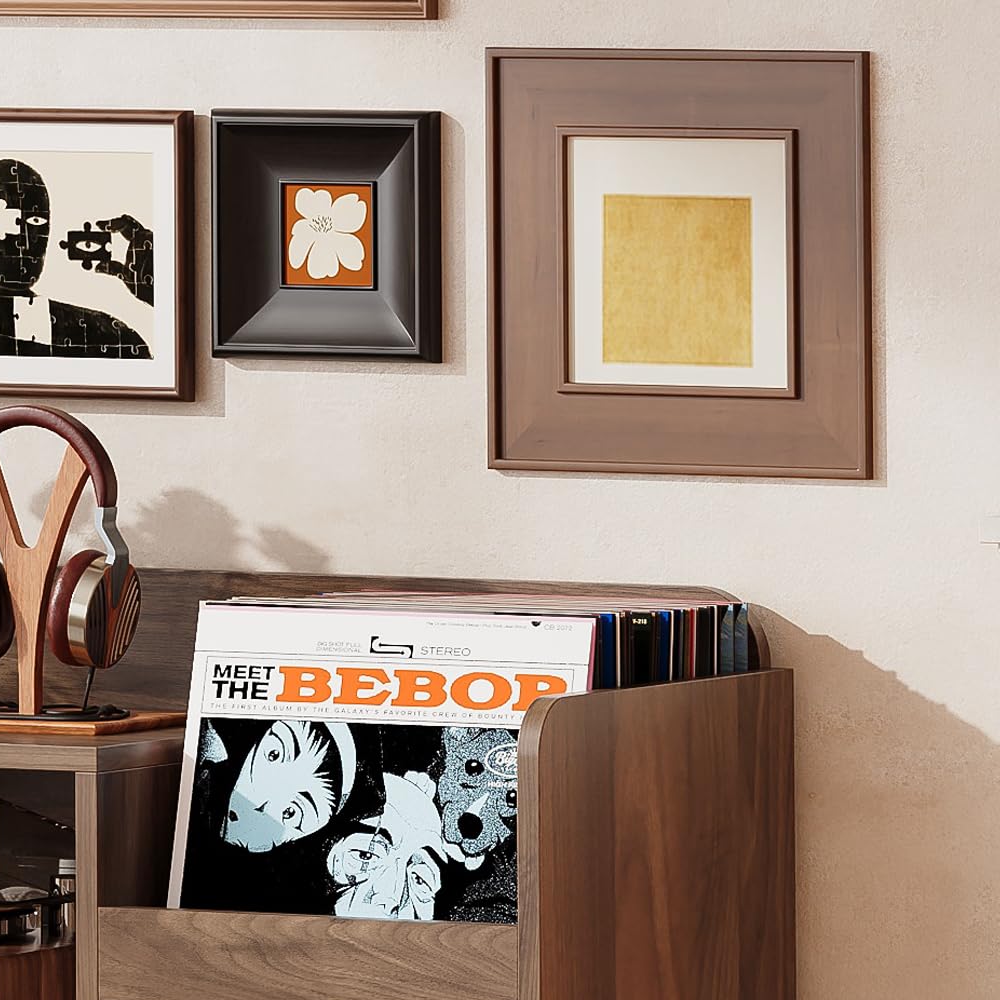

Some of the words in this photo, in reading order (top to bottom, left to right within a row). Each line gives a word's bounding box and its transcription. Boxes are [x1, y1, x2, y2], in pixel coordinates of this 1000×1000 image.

[420, 645, 471, 657] STEREO
[213, 664, 275, 680] MEET
[211, 680, 269, 700] THE
[276, 665, 567, 711] BEBOP
[210, 702, 228, 710] THE
[231, 703, 257, 711] FIRST
[334, 708, 380, 716] GALAXY'S
[383, 709, 428, 718] FAVORITE
[432, 711, 458, 719] CREW
[478, 713, 515, 721] BOUNTY
